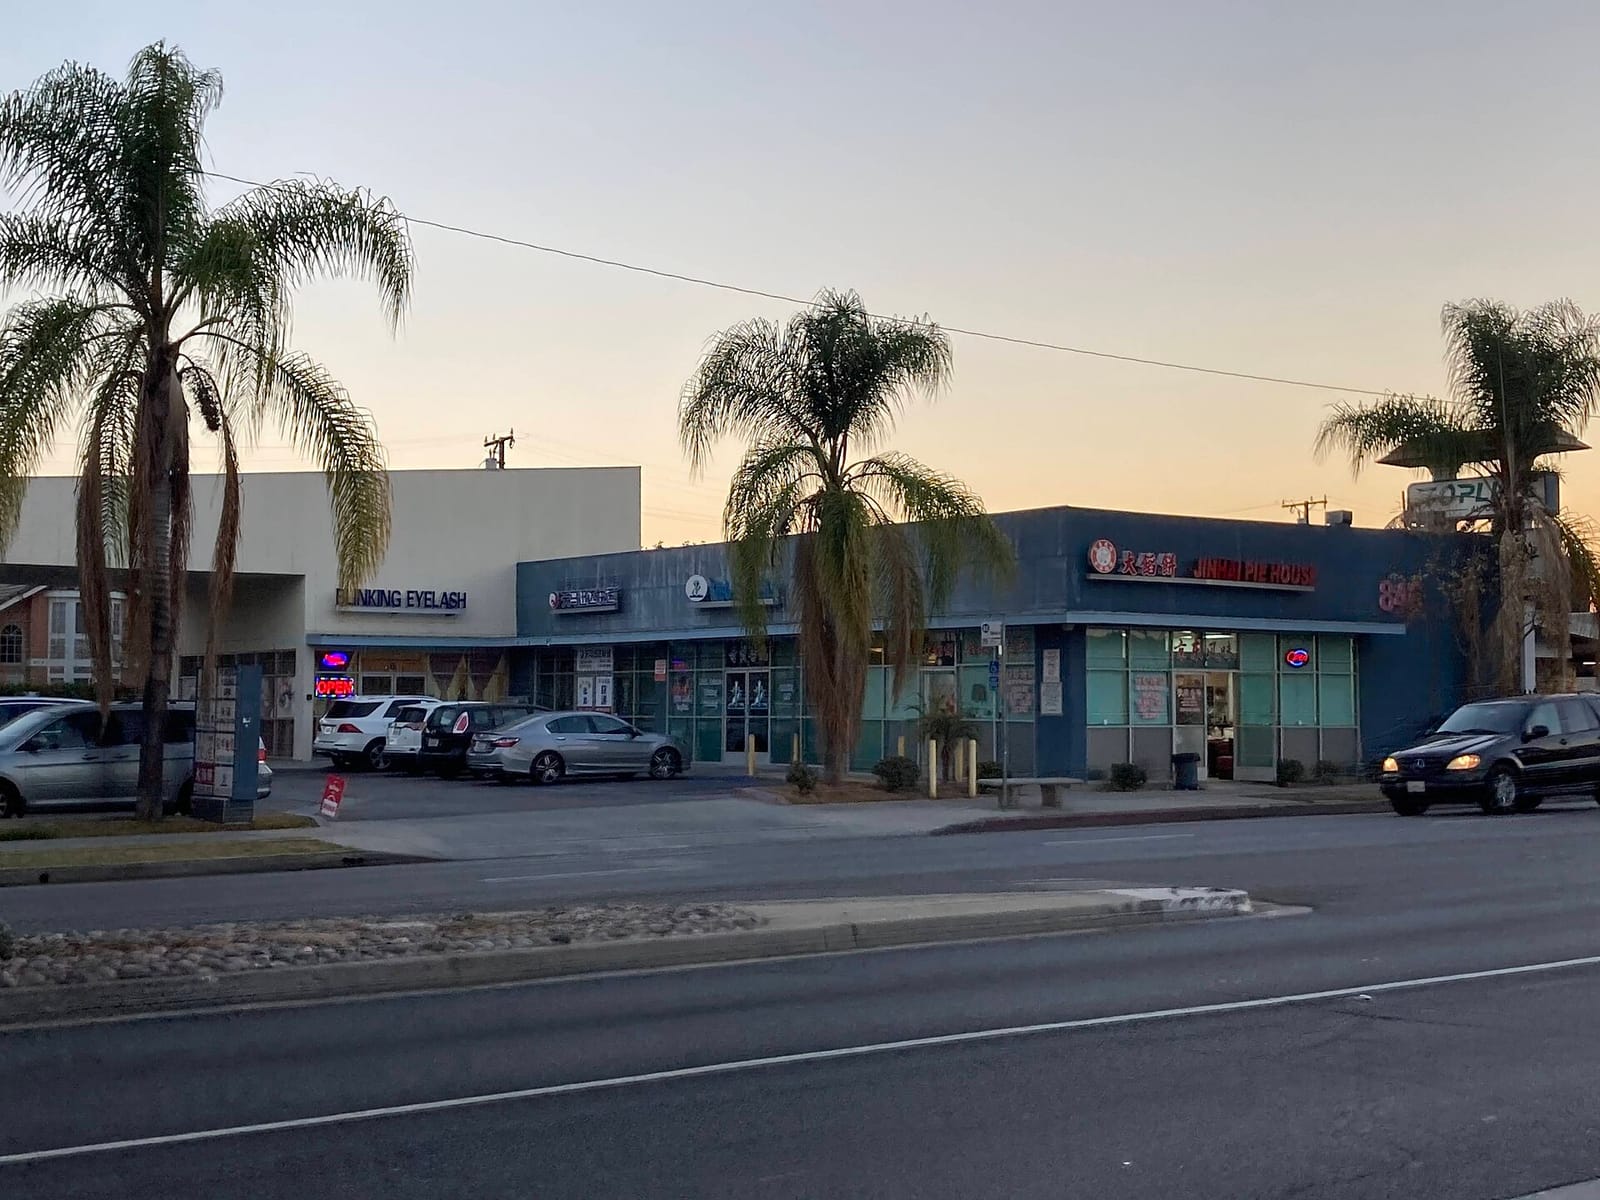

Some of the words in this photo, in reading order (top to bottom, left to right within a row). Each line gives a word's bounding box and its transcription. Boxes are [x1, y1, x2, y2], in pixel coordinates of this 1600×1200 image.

[1245, 560, 1268, 582] PIE
[406, 590, 467, 609] EYELASH
[318, 680, 353, 694] OPEN
